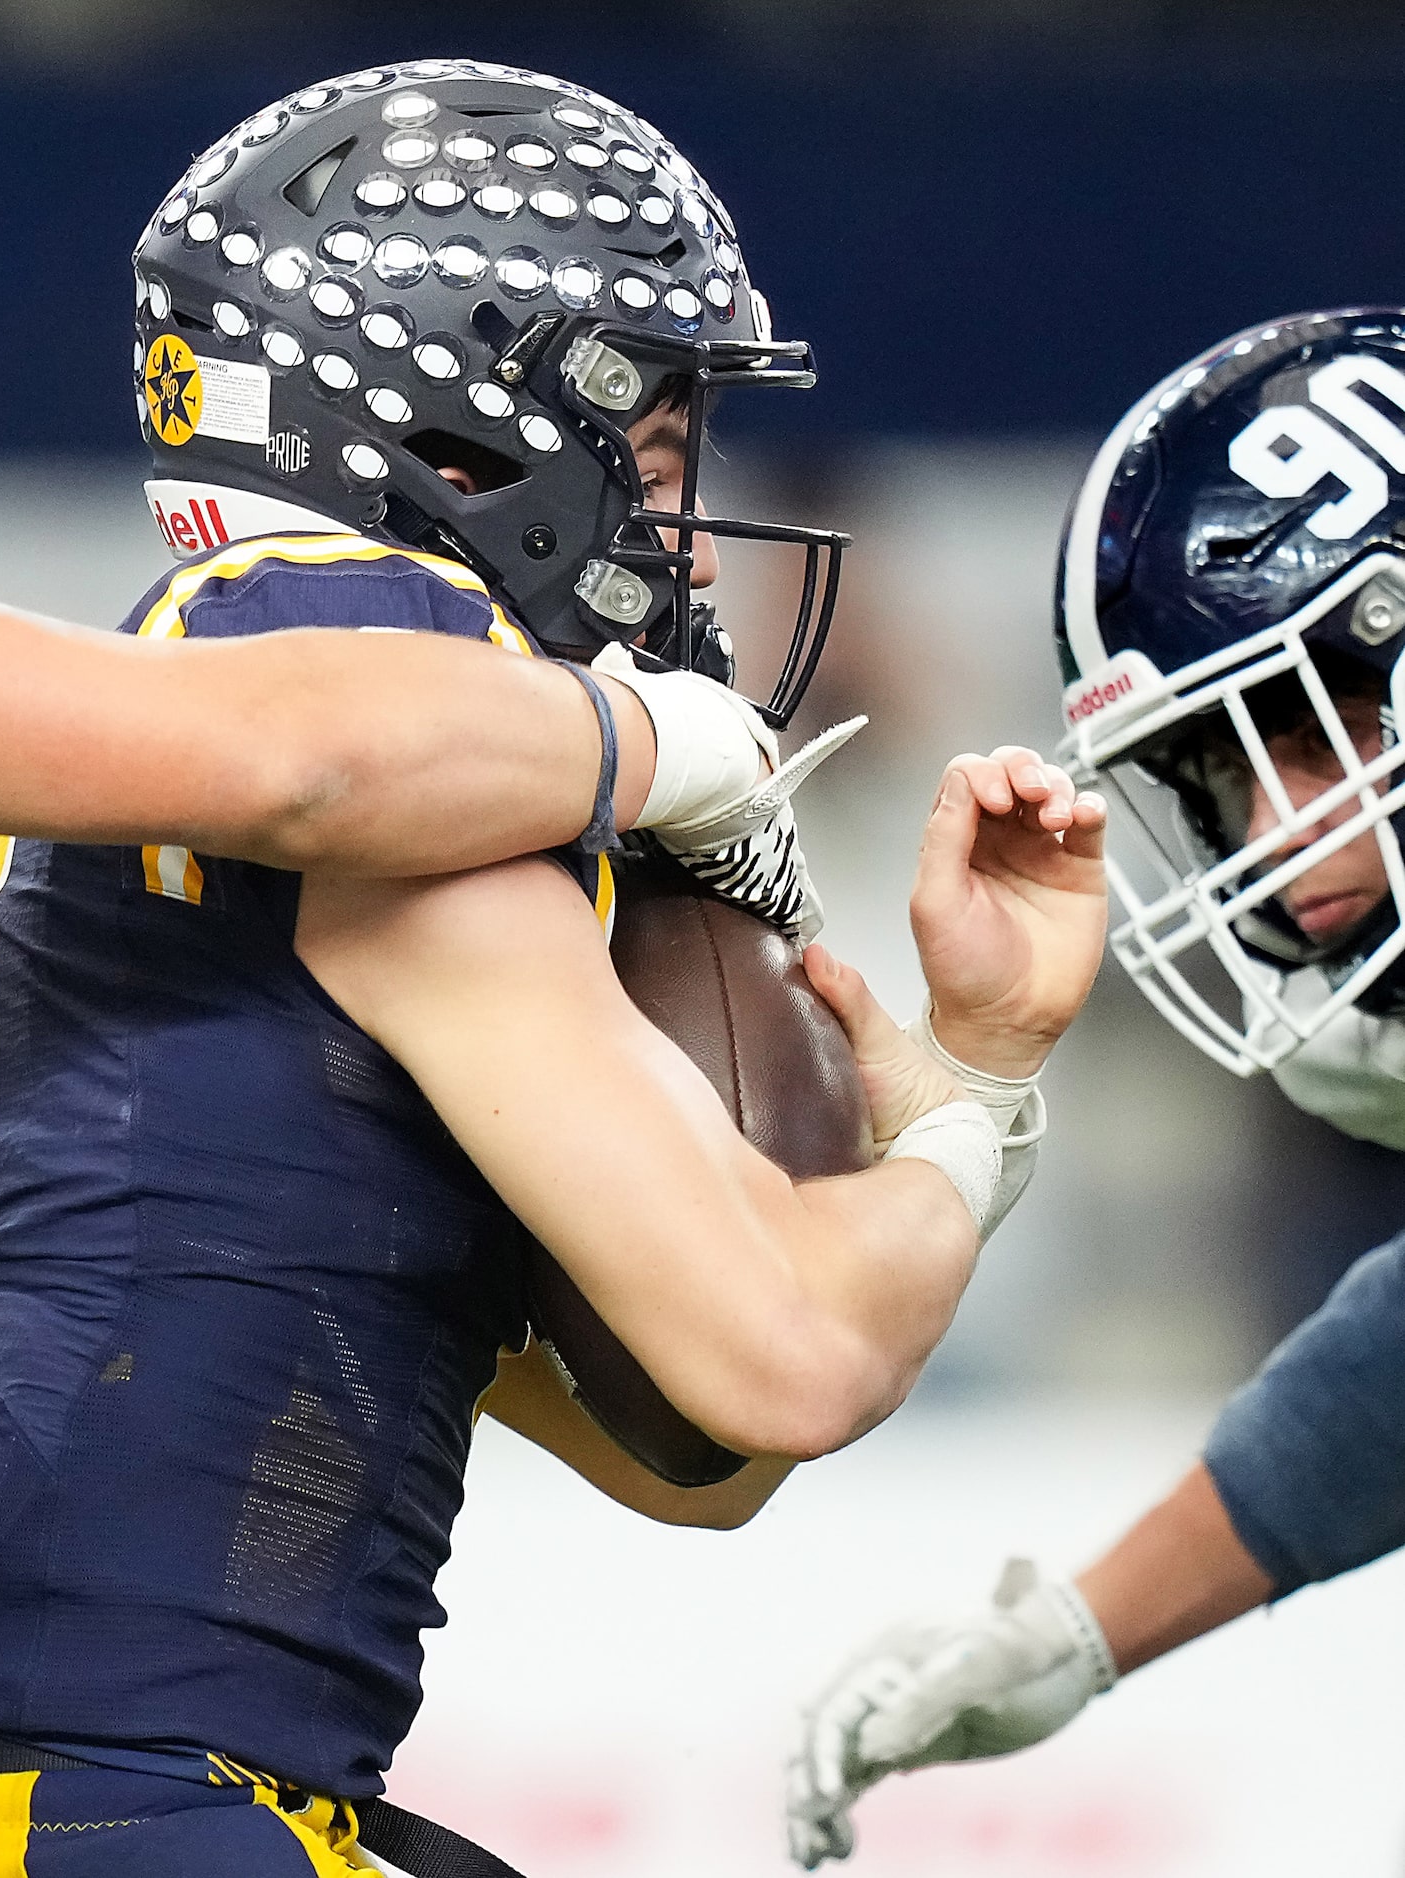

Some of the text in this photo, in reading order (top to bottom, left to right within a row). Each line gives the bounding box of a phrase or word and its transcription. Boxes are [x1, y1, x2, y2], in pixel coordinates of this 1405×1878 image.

[196, 360, 228, 373] ARNING
[266, 432, 310, 473] PRIDE
[1228, 354, 1405, 540] 90
